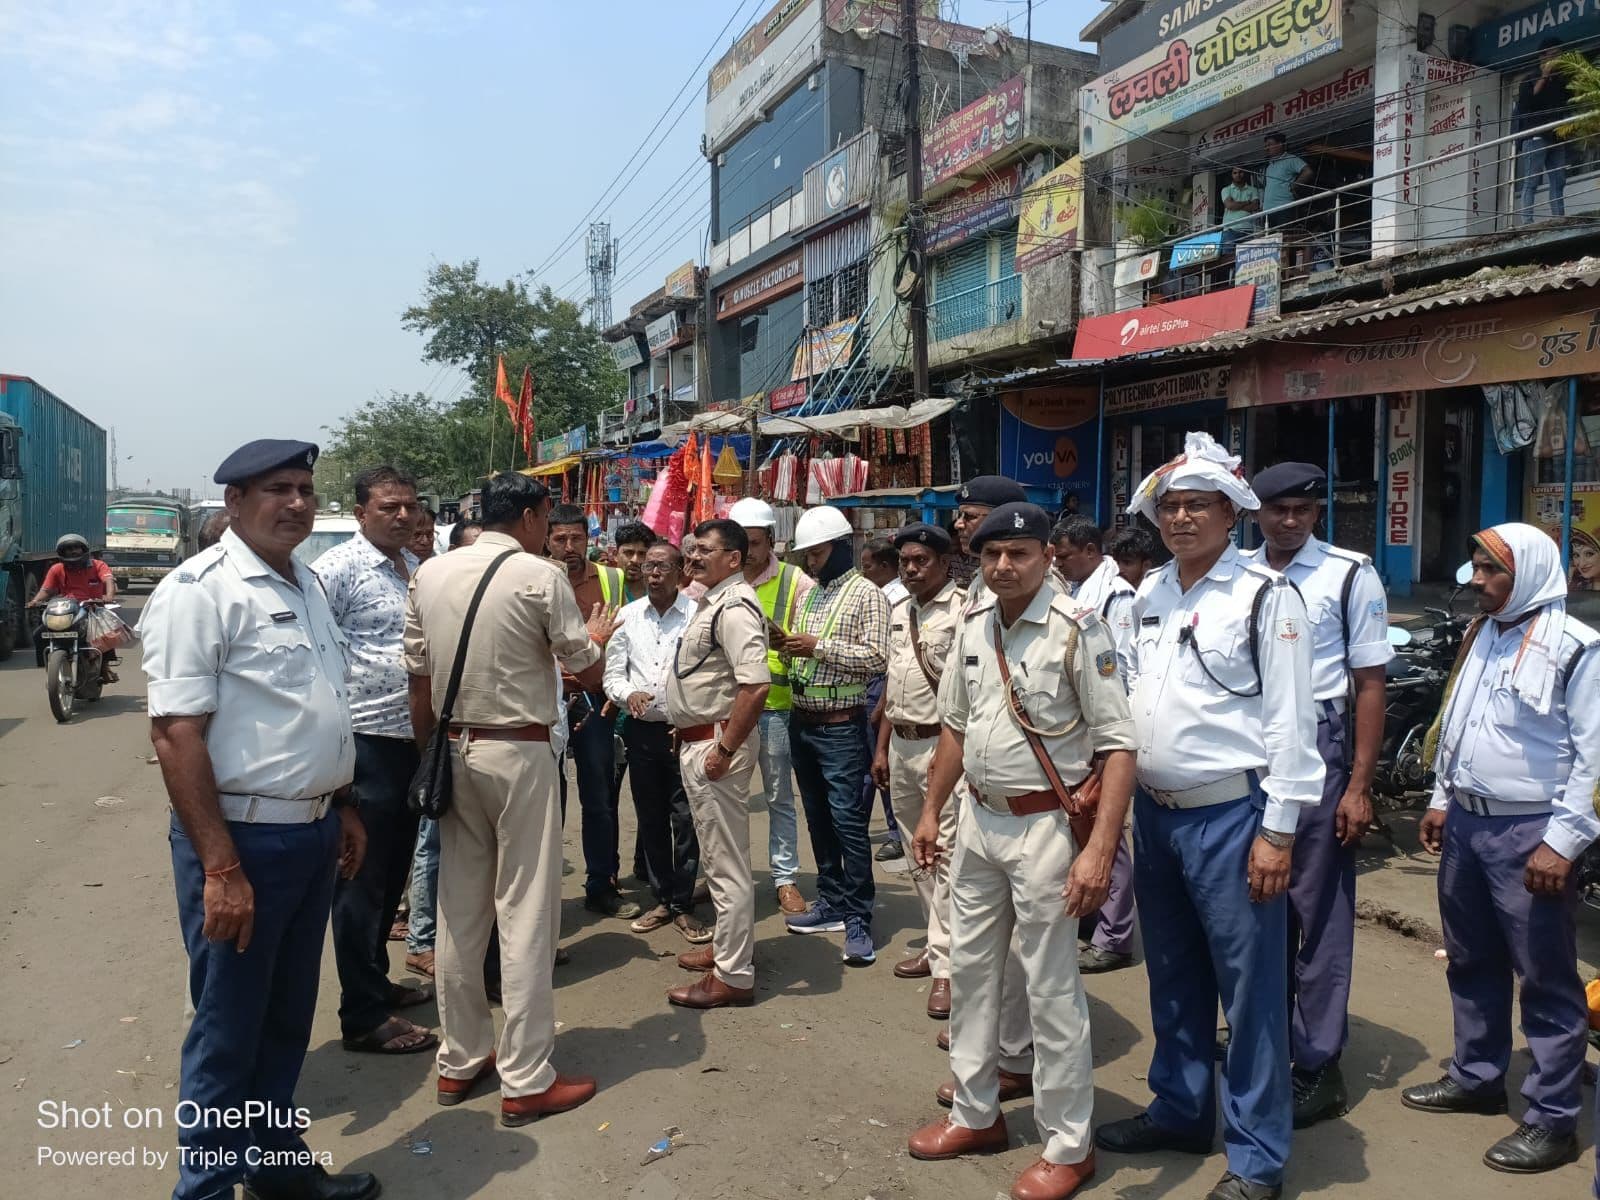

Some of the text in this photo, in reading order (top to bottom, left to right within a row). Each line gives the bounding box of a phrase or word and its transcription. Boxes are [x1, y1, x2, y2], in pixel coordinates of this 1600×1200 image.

[1109, 39, 1192, 119] लवली
[1472, 104, 1482, 217] COMUTER
[1176, 244, 1217, 262] vivo
[1139, 321, 1160, 336] airtel
[1393, 392, 1412, 438] NIL
[1389, 439, 1416, 467] BOOK
[1391, 471, 1410, 545] STORE
